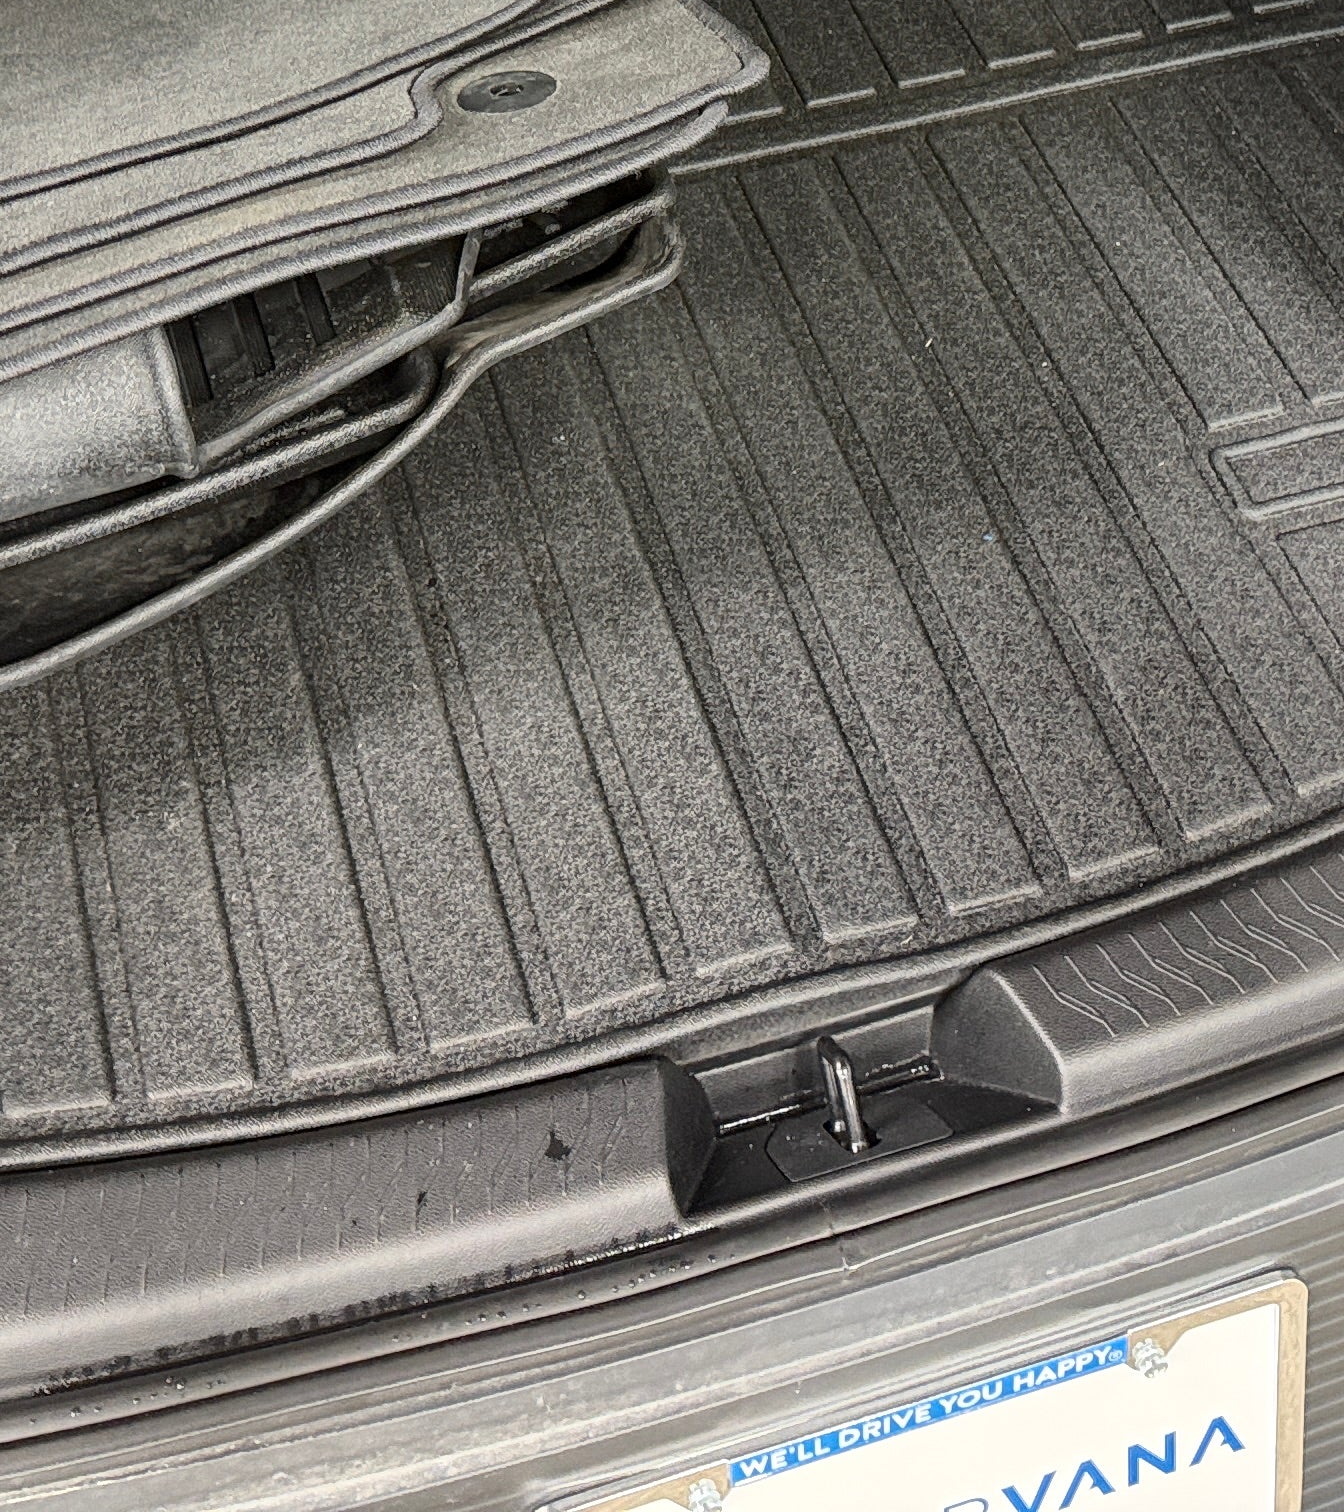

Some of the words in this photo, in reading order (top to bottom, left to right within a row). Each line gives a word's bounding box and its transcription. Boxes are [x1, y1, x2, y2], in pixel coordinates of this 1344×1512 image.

[739, 1437, 831, 1478] WE'LL
[838, 1403, 932, 1449] DRIVE
[939, 1380, 1003, 1415] YOU
[943, 1415, 1246, 1512] VANA
